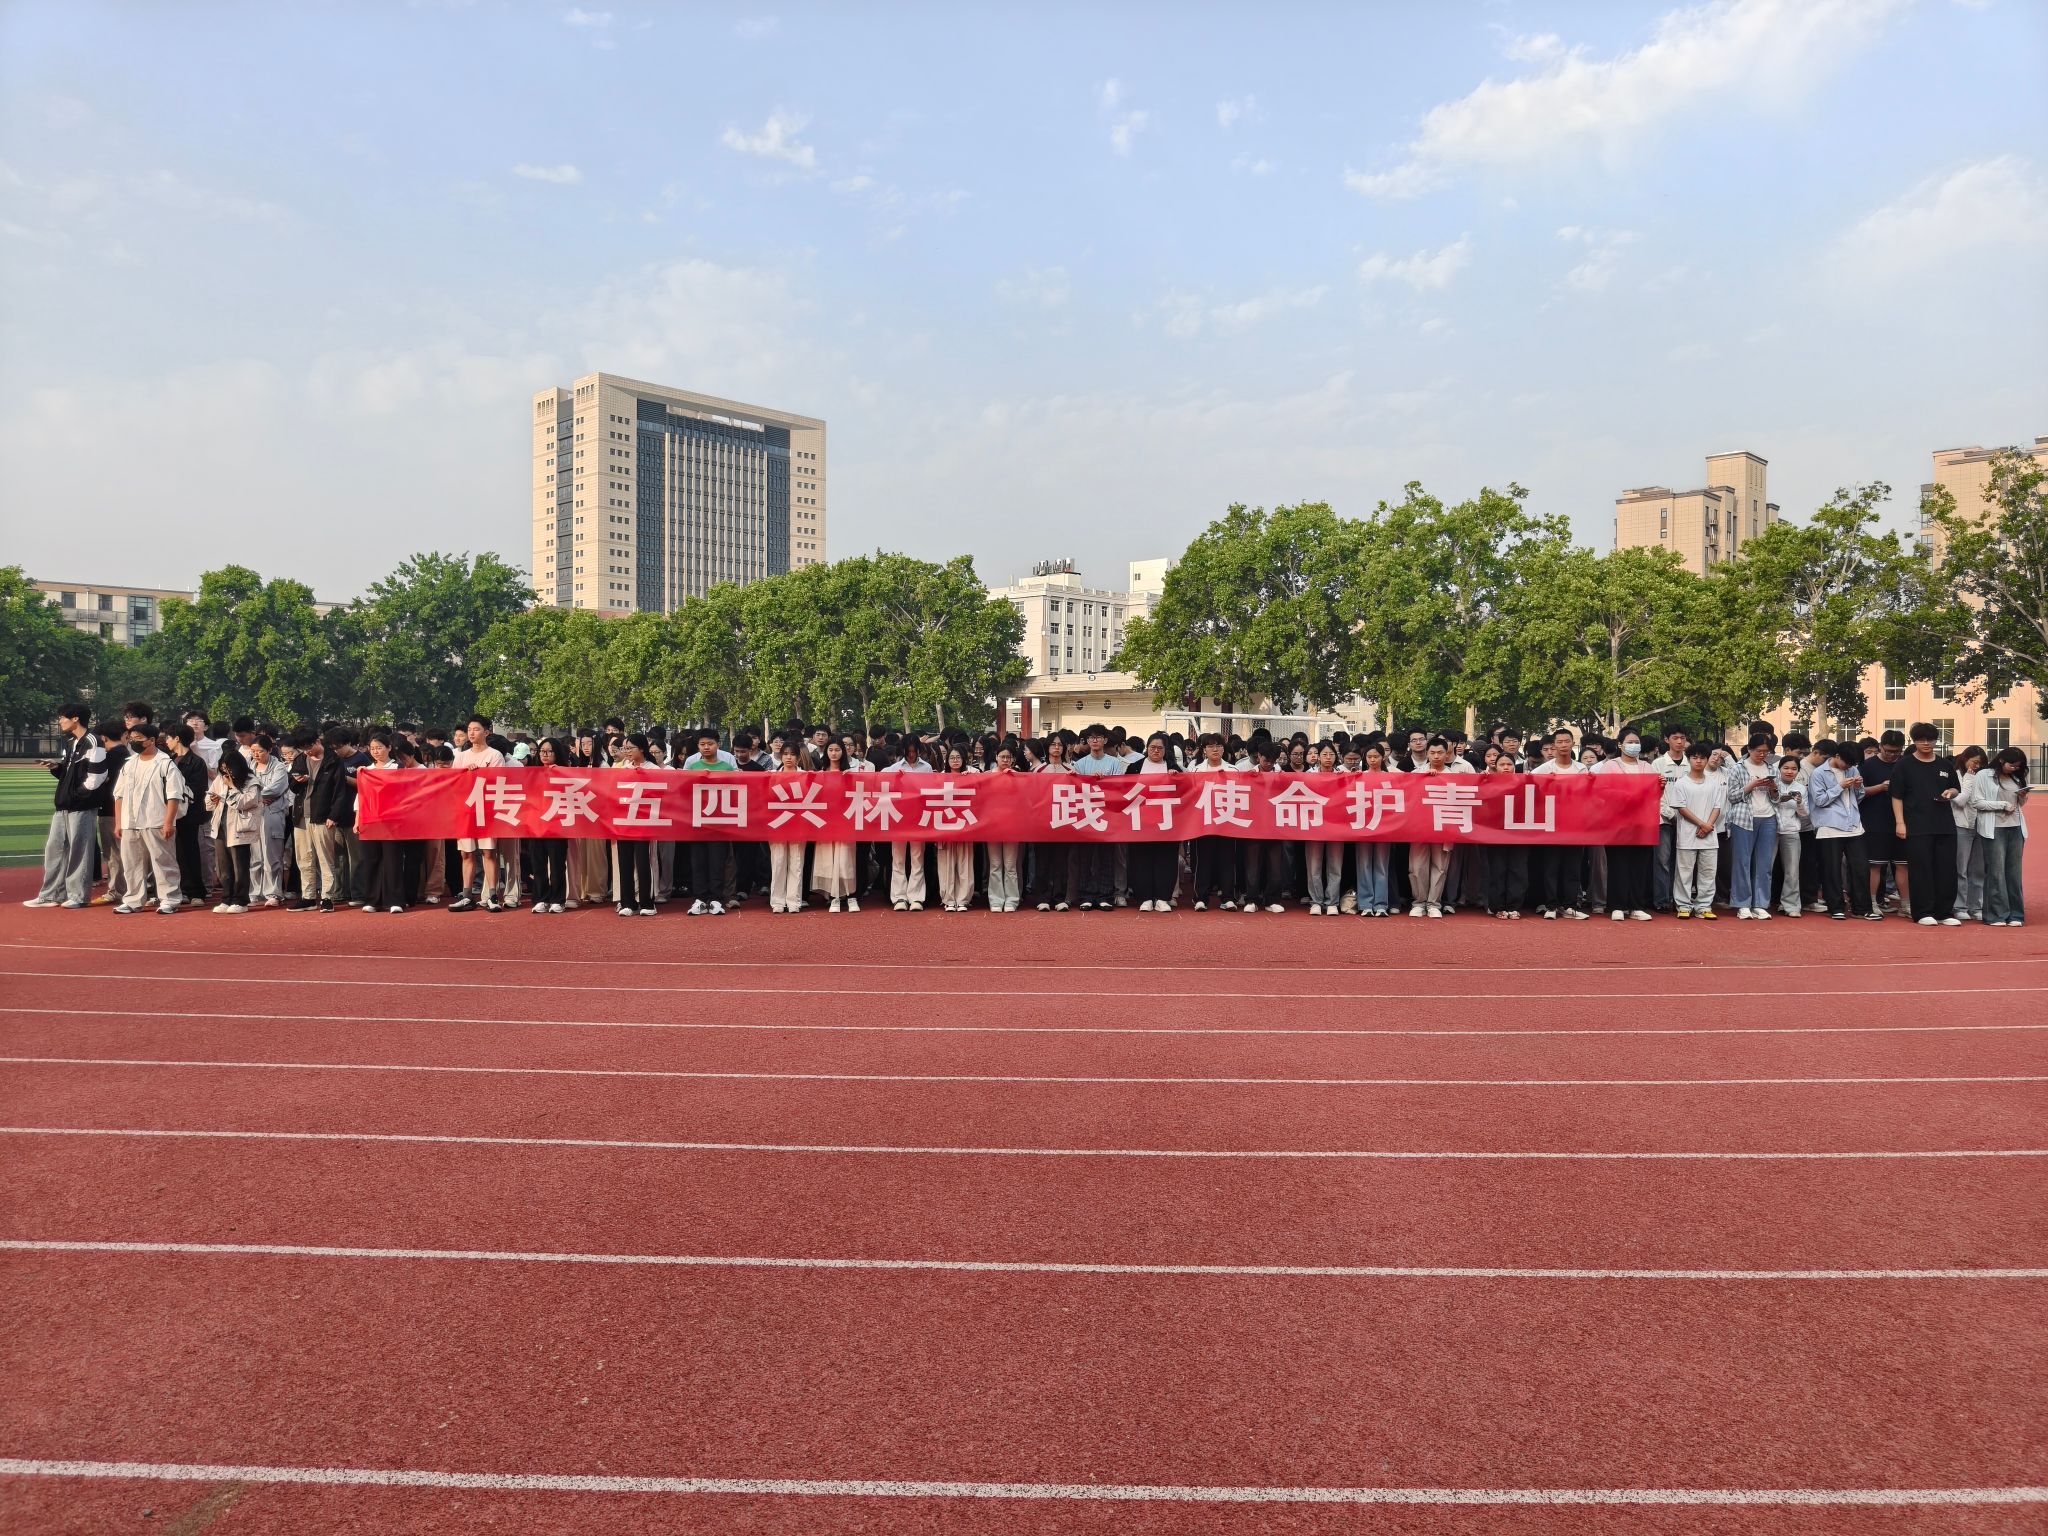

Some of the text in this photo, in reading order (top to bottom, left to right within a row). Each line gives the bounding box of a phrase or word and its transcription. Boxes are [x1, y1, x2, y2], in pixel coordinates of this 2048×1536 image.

[465, 776, 1556, 834] 传承五四兴林志 践行使命护青山
